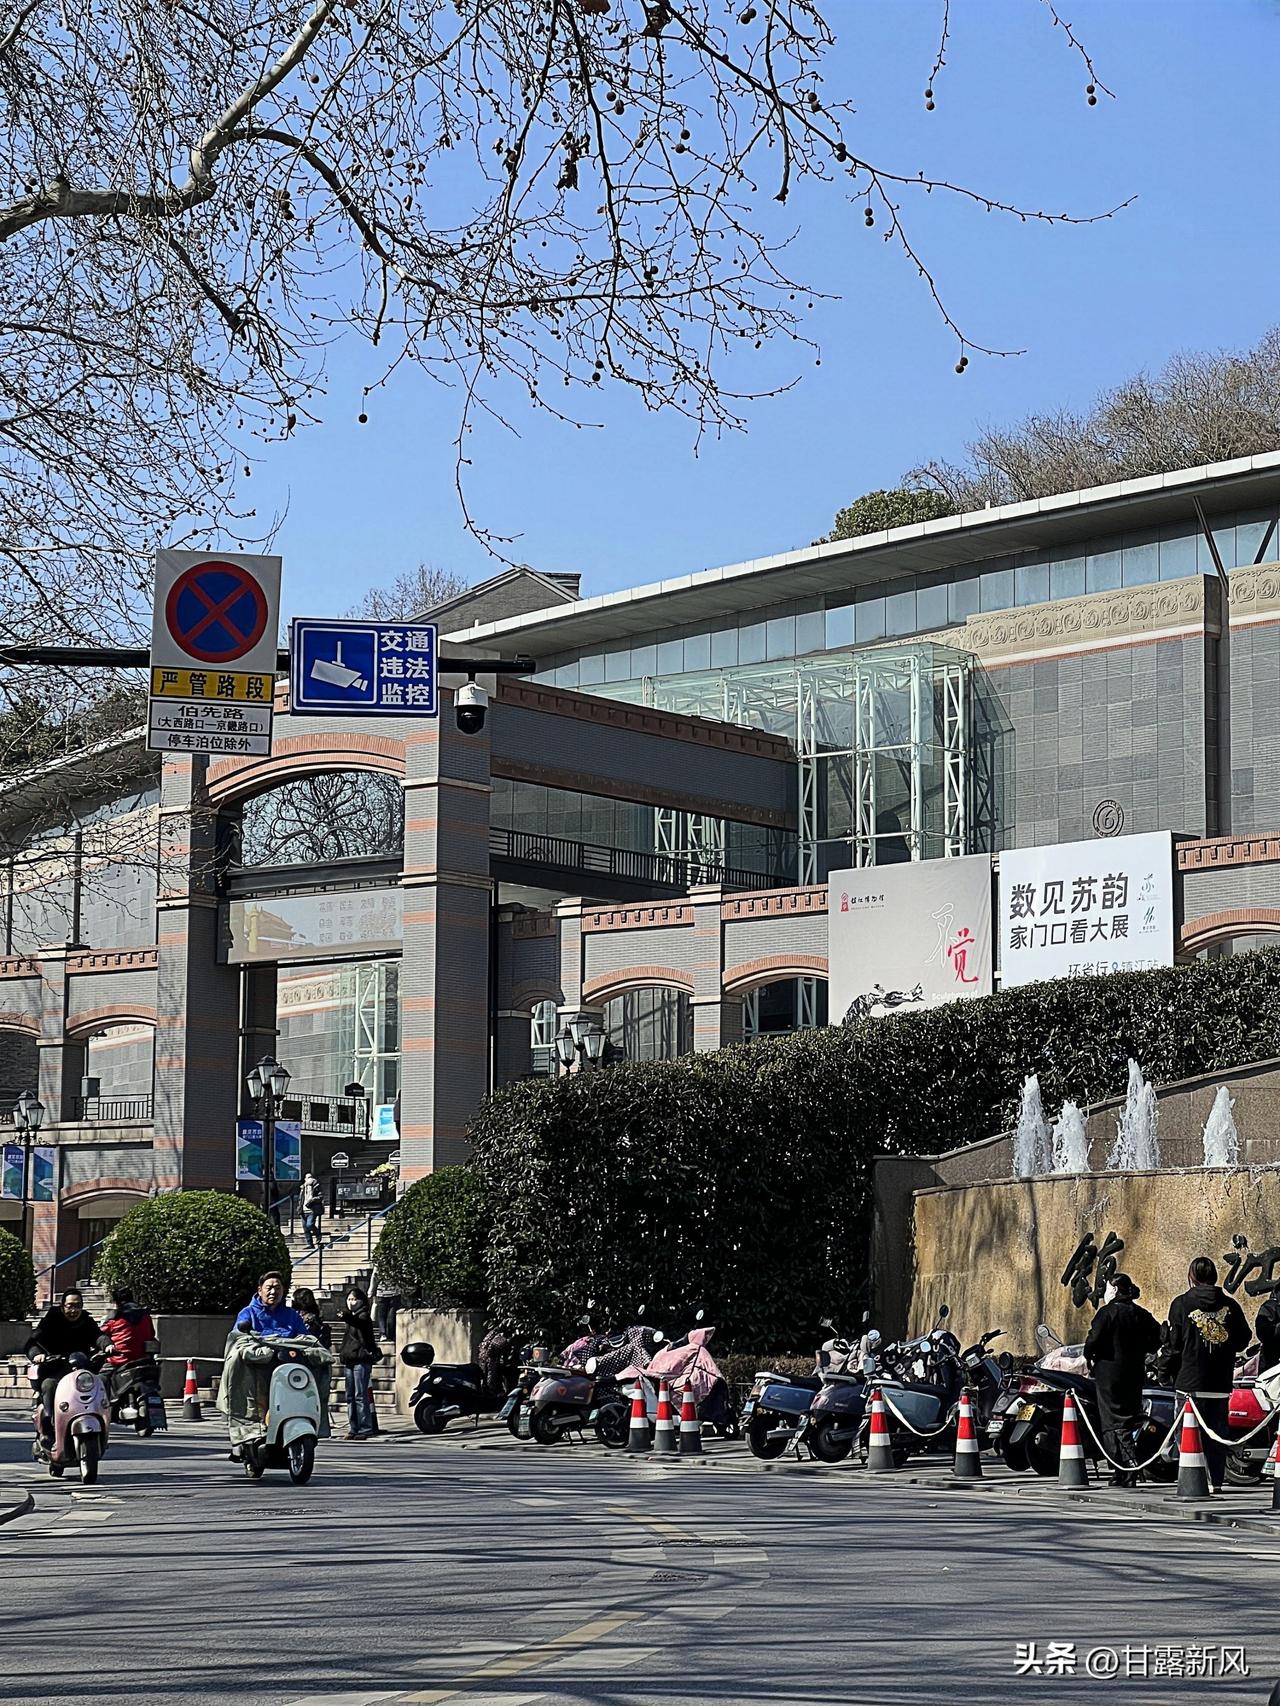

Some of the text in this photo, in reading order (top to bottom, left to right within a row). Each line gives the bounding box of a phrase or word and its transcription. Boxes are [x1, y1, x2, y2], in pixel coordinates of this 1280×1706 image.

[380, 630, 430, 652] 交通
[380, 657, 430, 679] 违法
[160, 671, 264, 699] 严管路段
[380, 684, 430, 706] 监控
[178, 705, 245, 720] 伯先路
[167, 734, 251, 751] 停车泊位除外
[1009, 872, 1129, 919] 数见苏韵
[1009, 914, 1129, 950] 家门口看大展
